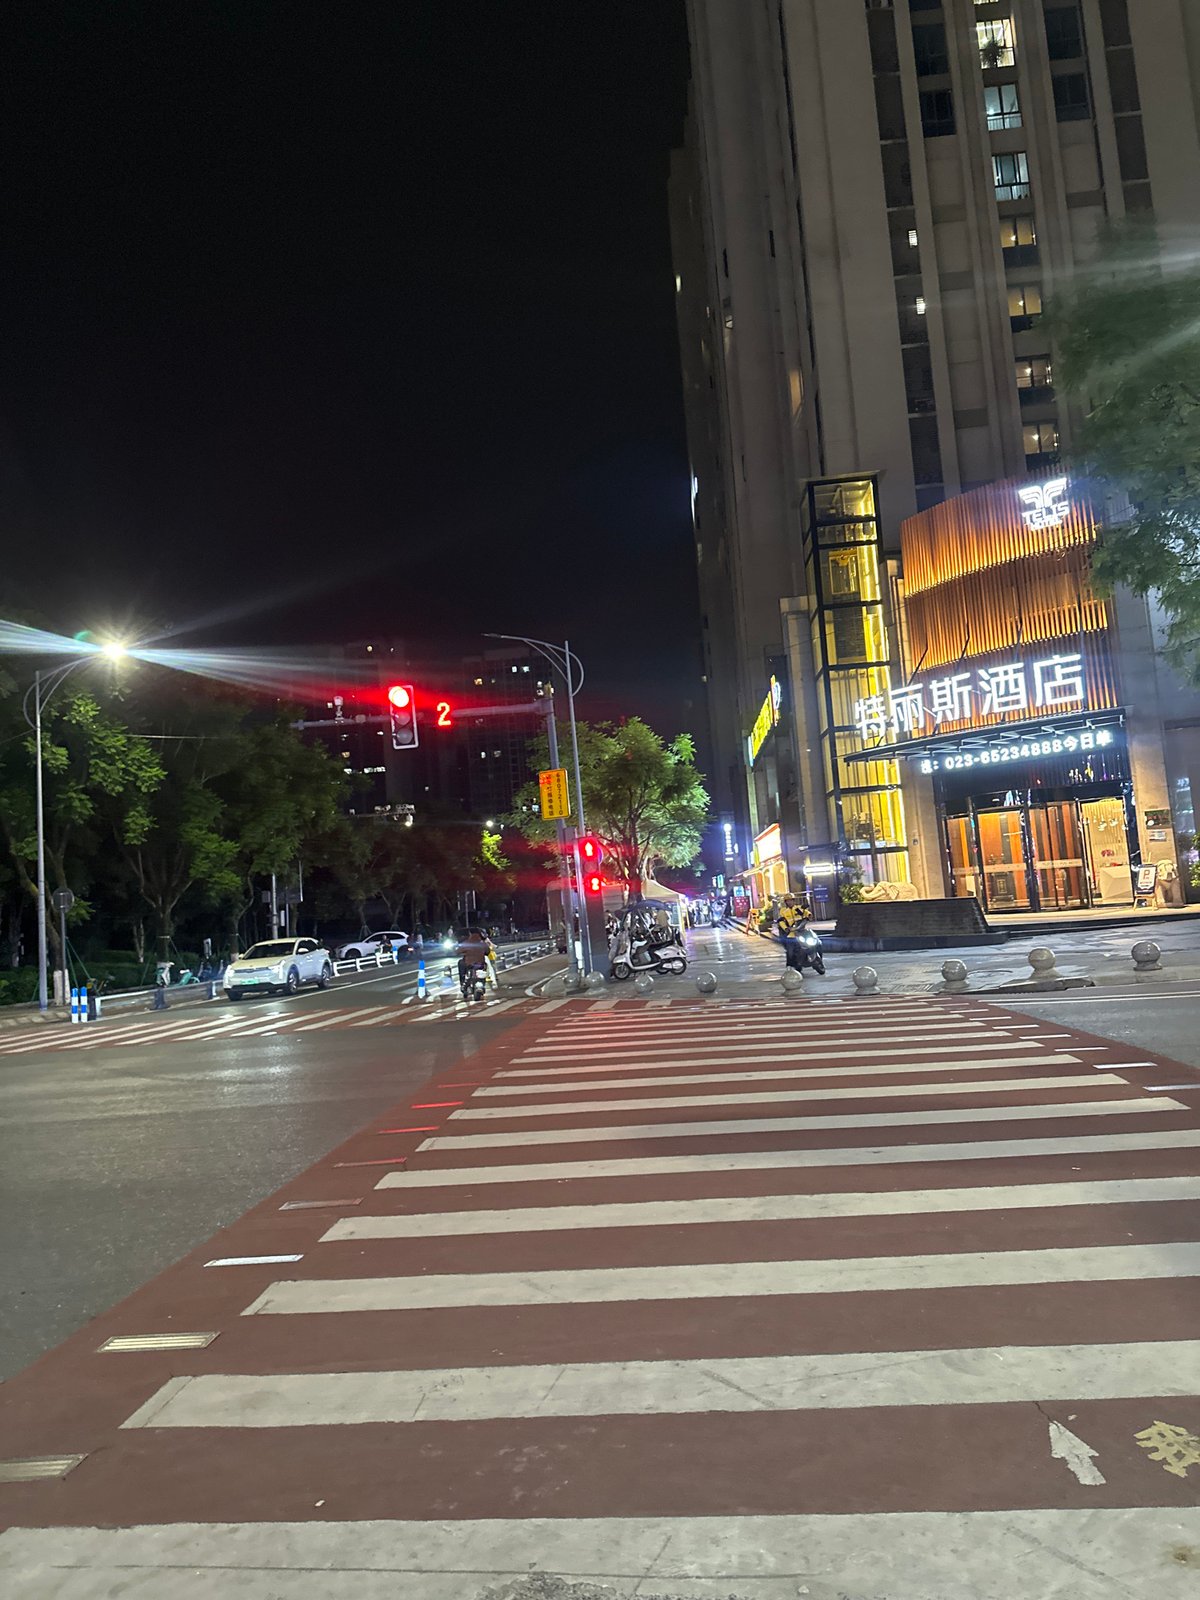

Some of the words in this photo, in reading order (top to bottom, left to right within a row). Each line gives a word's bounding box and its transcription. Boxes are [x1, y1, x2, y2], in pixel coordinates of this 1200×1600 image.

[436, 701, 452, 727] 2
[854, 653, 1085, 741] 特丽斯酒店
